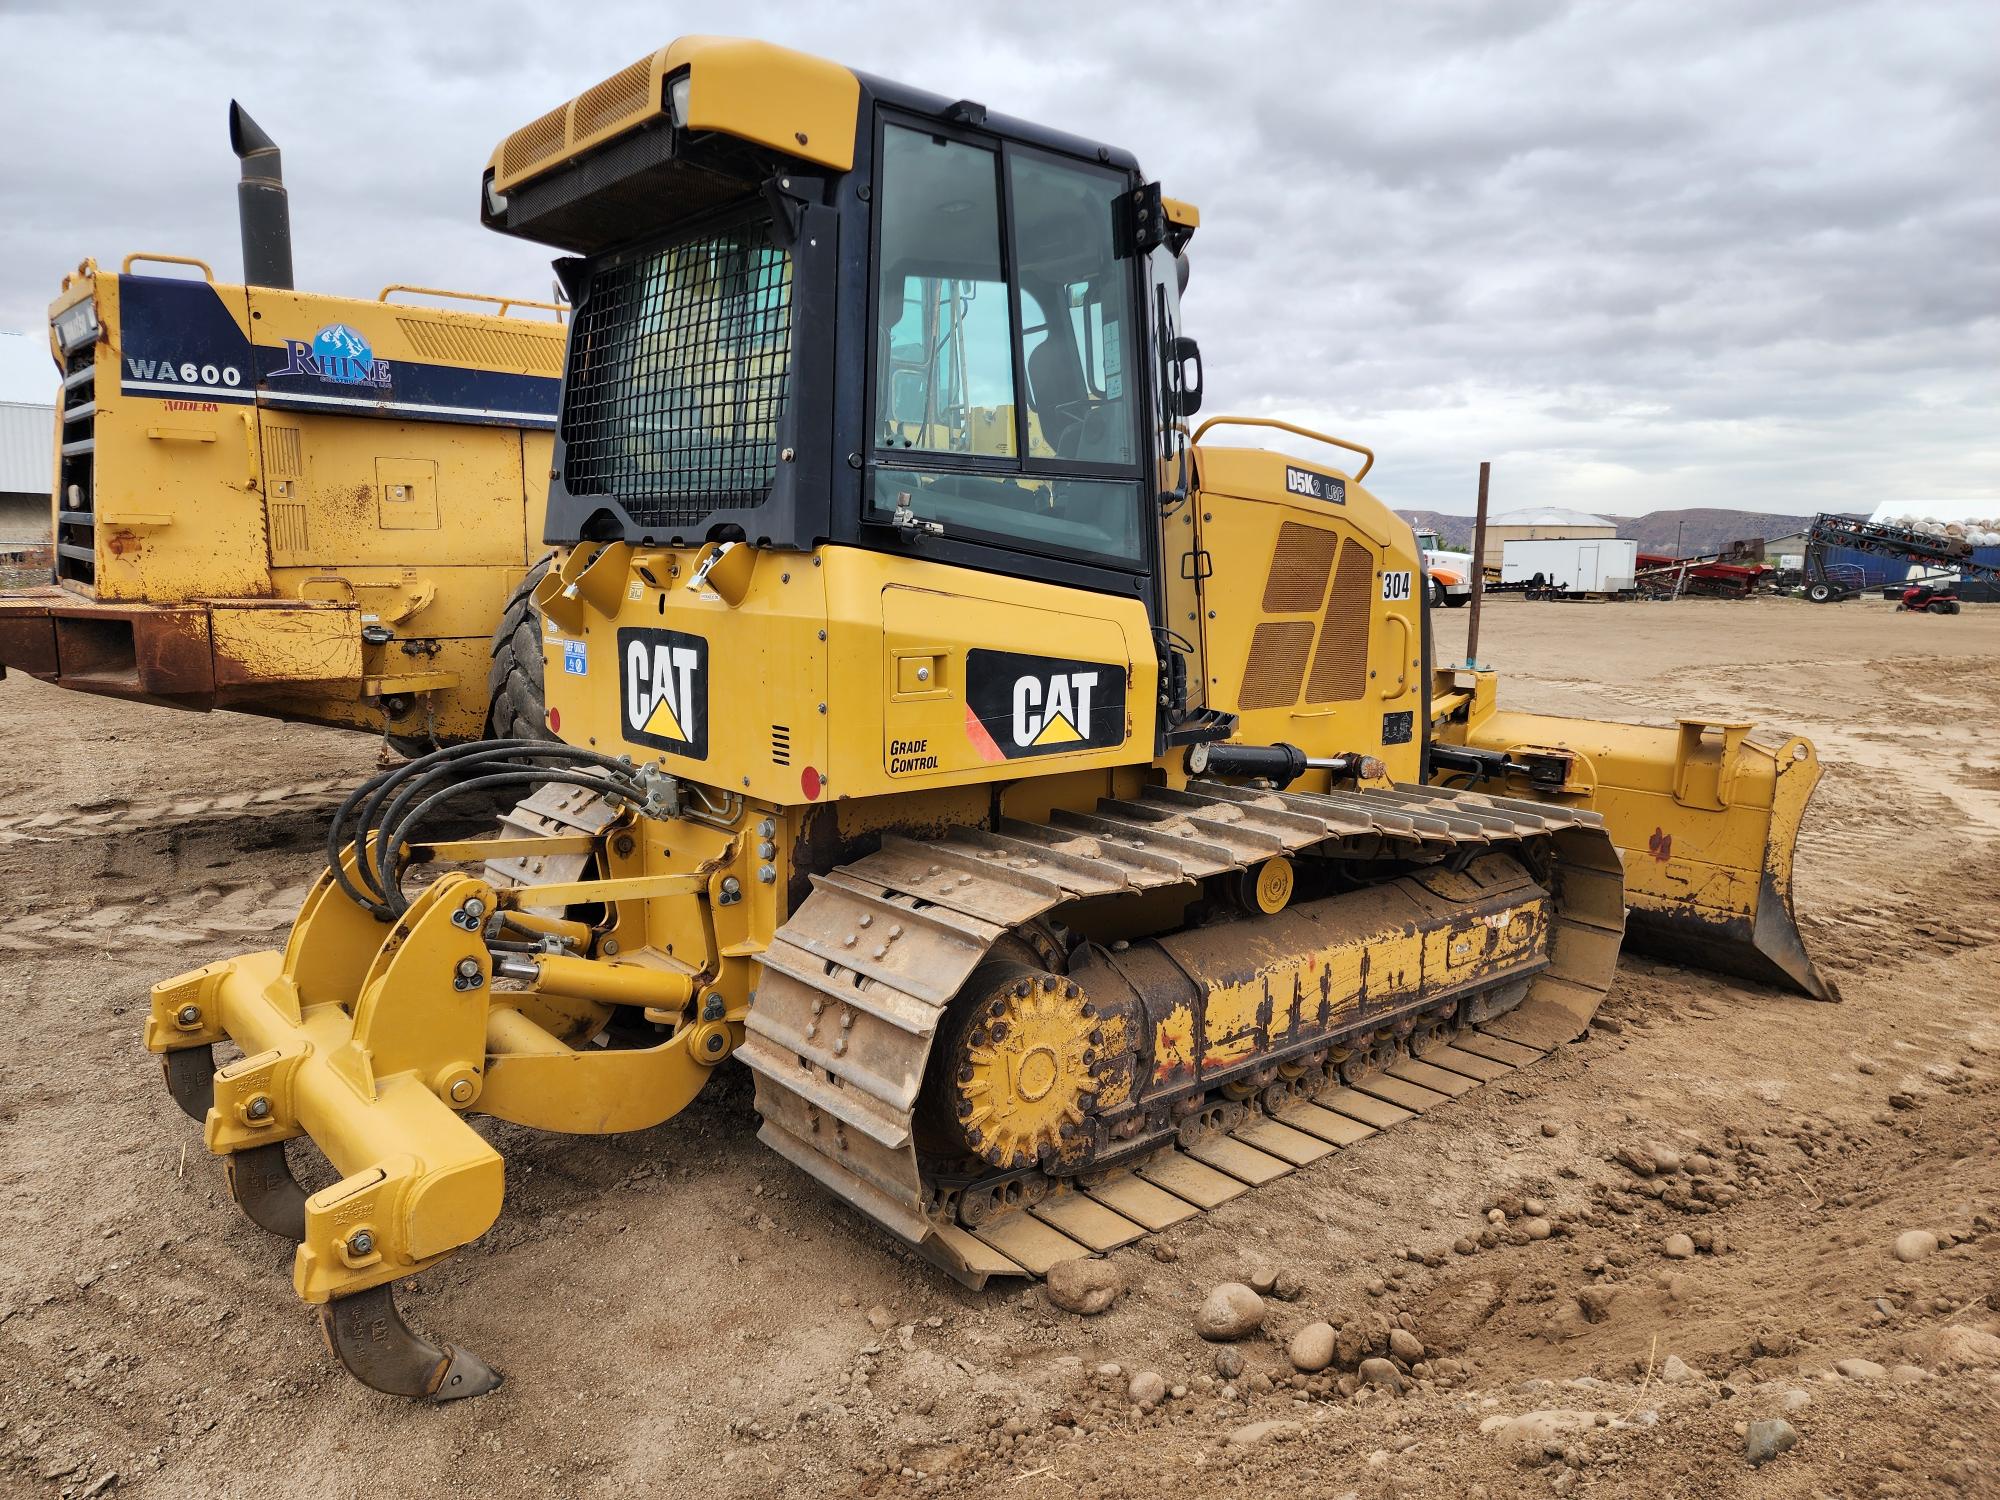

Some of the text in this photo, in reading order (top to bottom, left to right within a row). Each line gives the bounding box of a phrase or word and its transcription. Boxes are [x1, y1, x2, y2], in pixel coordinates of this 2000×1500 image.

[127, 358, 241, 387] WA600
[266, 338, 392, 383] RHINE
[1383, 572, 1411, 600] 304
[627, 639, 698, 744] CAT
[1012, 671, 1099, 747] CAT
[890, 739, 928, 756] GRADE
[890, 755, 939, 774] CONTROL
